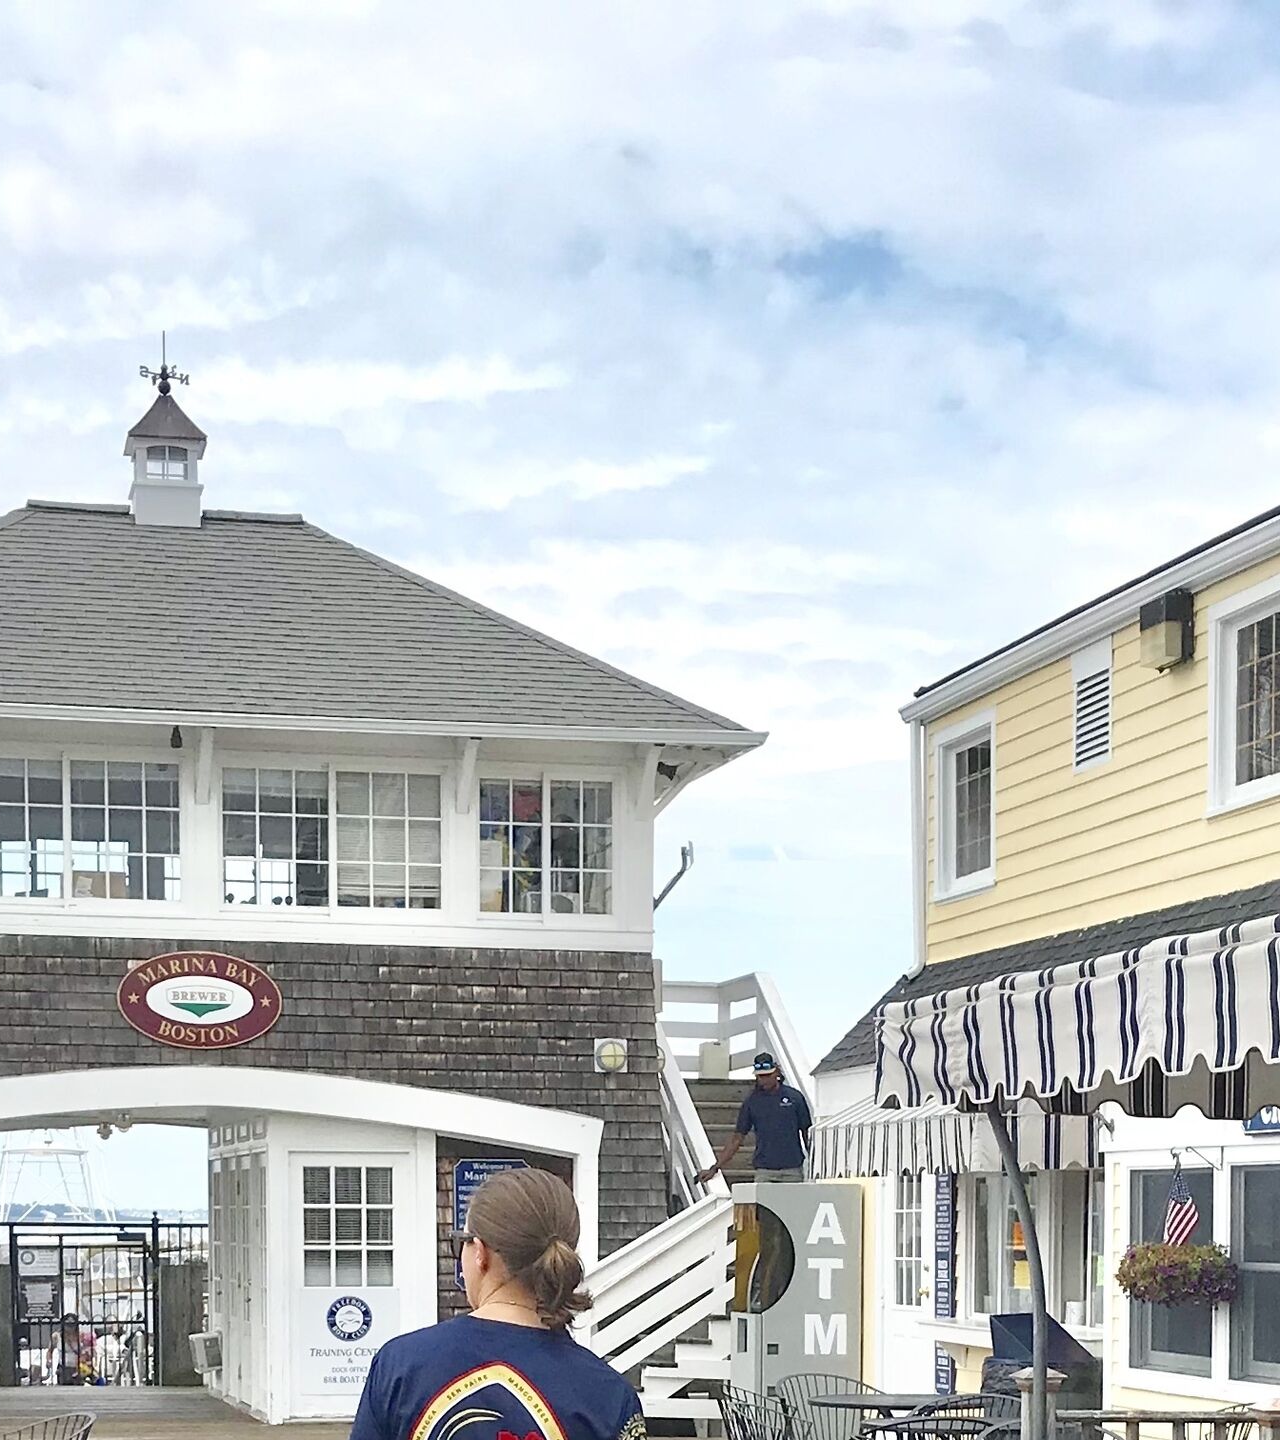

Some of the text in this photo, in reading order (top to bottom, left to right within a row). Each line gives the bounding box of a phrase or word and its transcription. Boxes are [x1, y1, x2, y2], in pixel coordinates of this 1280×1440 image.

[137, 958, 261, 987] MARINA BAY
[172, 991, 227, 1001] BREWER
[158, 1021, 239, 1043] BOSTON
[464, 1171, 487, 1180] Mari
[804, 1203, 847, 1355] ATM
[332, 1298, 367, 1312] FREEDOM
[331, 1324, 368, 1339] BOAT CLUB
[309, 1347, 379, 1357] TRAINING CENT
[339, 1376, 360, 1384] BOAT
[507, 1377, 549, 1424] MANGO BEER
